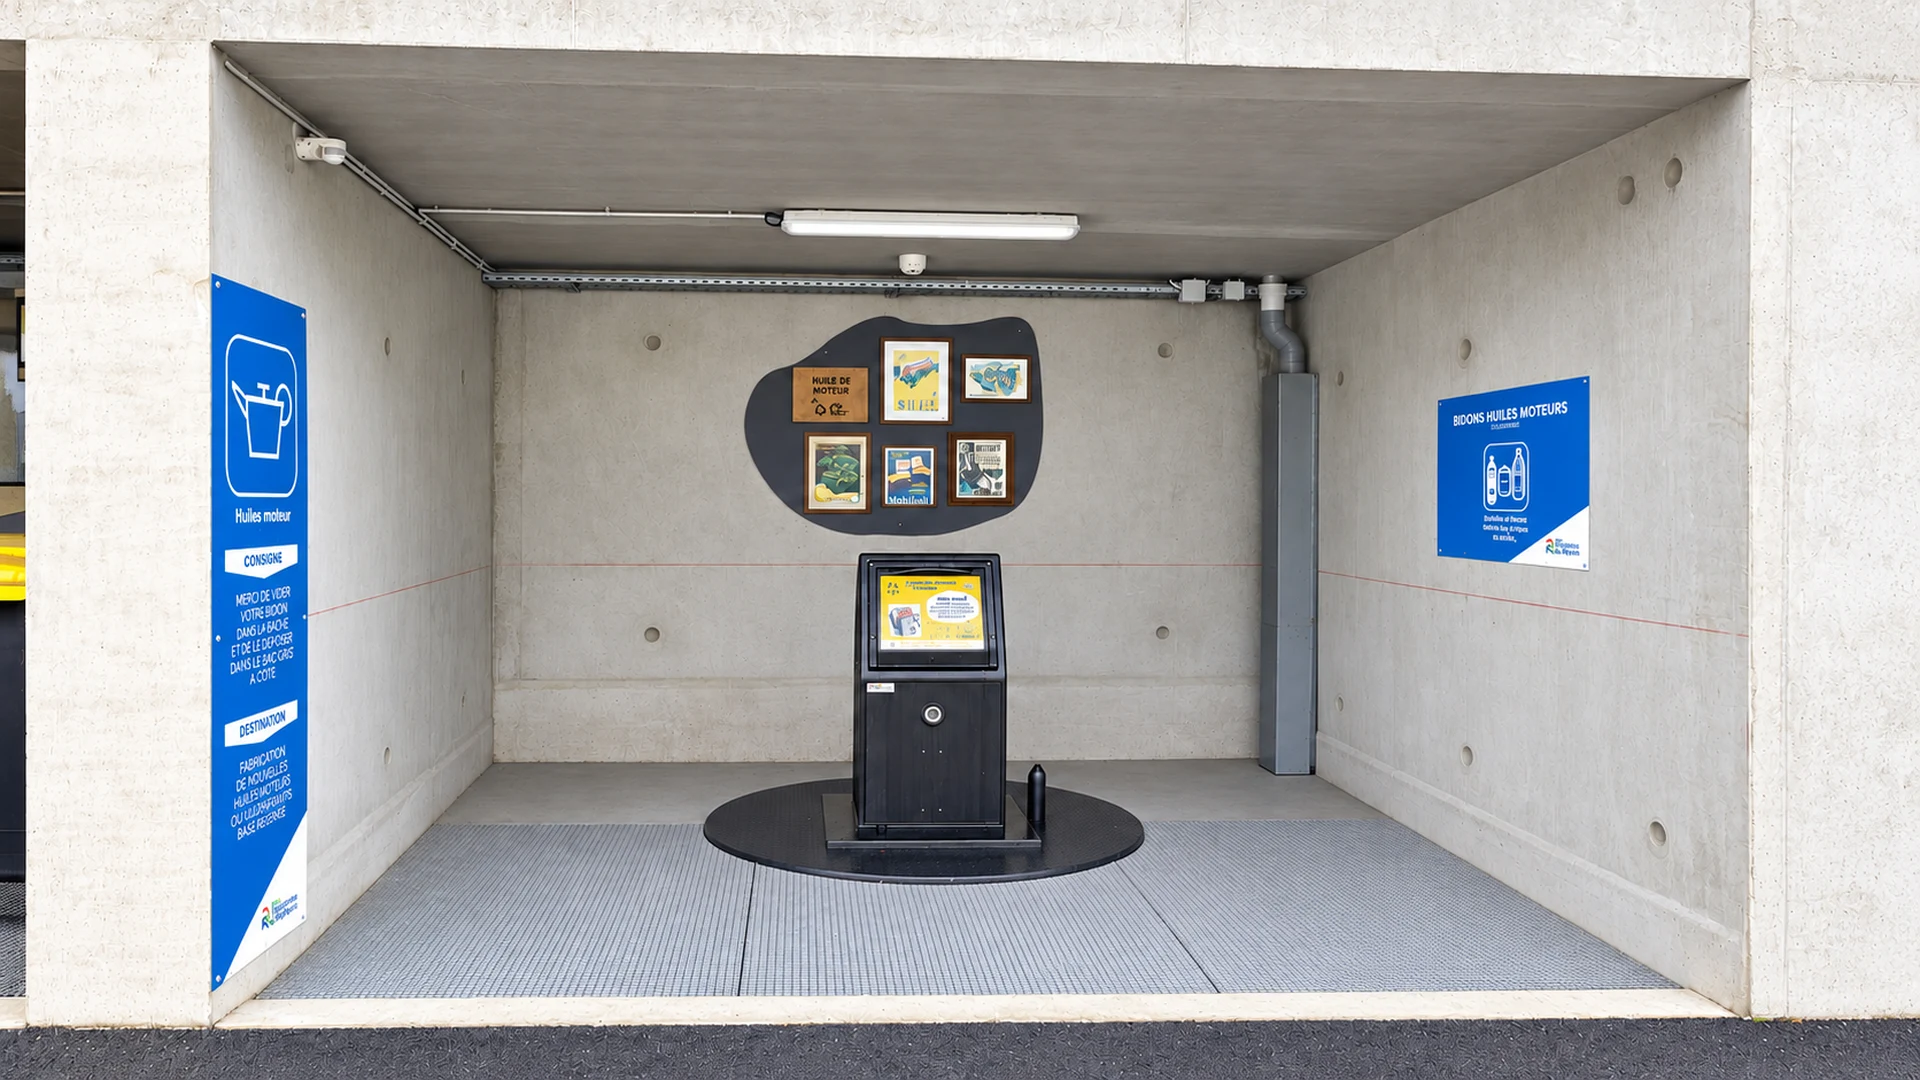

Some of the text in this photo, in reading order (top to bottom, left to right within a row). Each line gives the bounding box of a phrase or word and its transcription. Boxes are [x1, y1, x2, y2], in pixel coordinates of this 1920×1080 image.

[812, 376, 851, 385] HUILE DE
[812, 387, 849, 395] MOTEUR
[1453, 411, 1485, 427] BIDONS
[1486, 406, 1518, 423] HUILES
[1519, 400, 1568, 419] MOTEURS
[235, 507, 292, 524] Huiles moteur
[244, 551, 282, 568] CONSIGNE
[260, 588, 270, 603] DE
[240, 606, 264, 623] VOTRE
[236, 624, 256, 641] DANS
[257, 622, 266, 636] LA
[231, 643, 240, 659] ET
[241, 640, 251, 656] DE
[252, 639, 261, 653] LE
[230, 656, 252, 675] DANS
[252, 655, 260, 669] LE
[239, 709, 286, 738] DESTINATION
[239, 744, 287, 775] FABRICATION
[236, 776, 247, 793] DE
